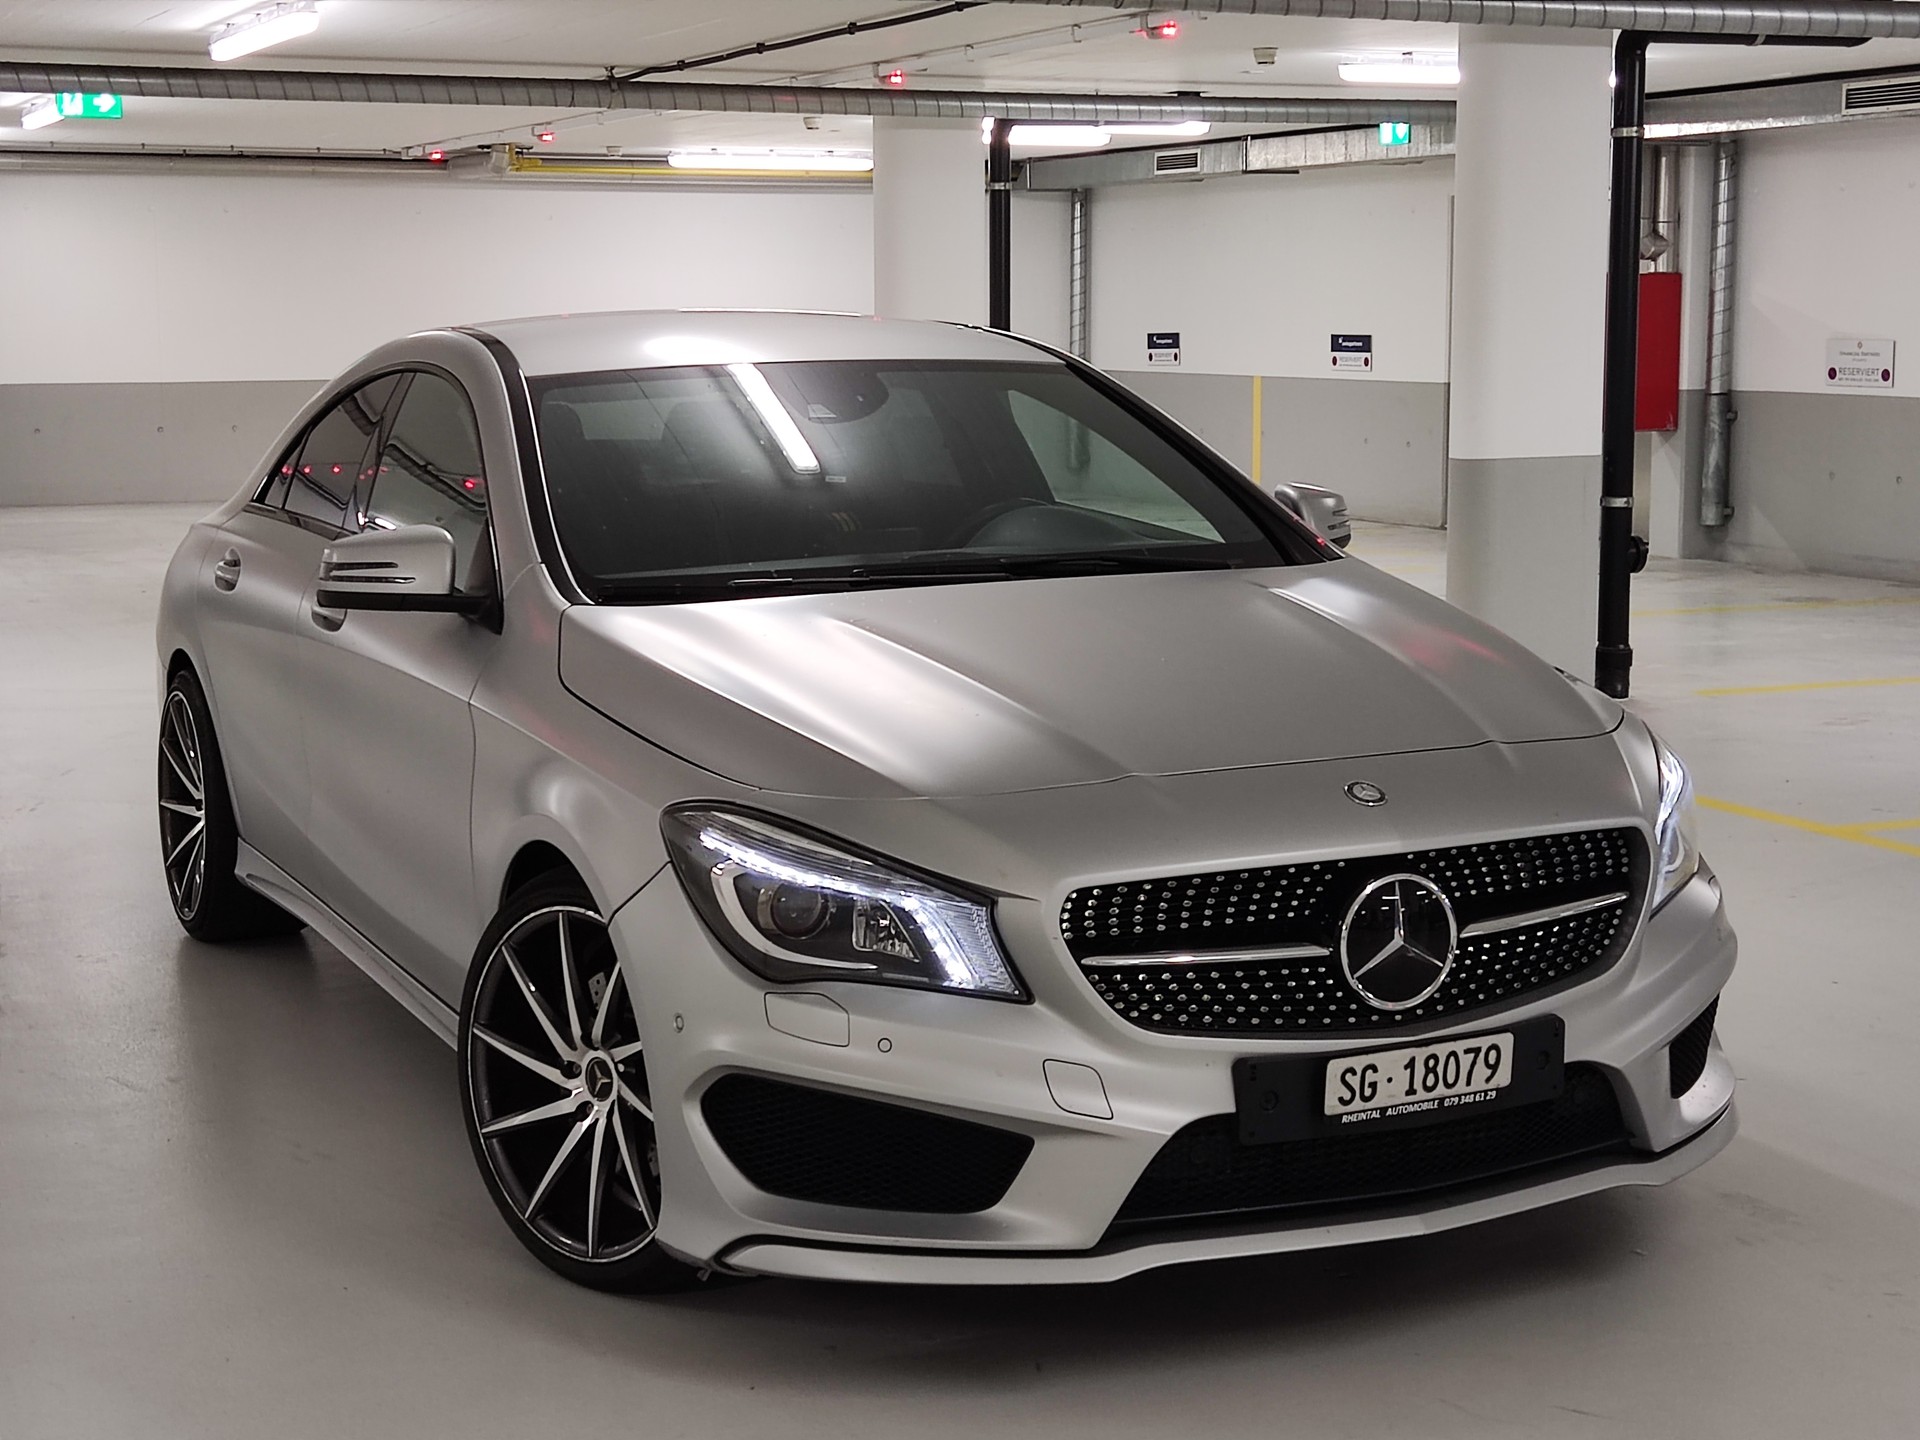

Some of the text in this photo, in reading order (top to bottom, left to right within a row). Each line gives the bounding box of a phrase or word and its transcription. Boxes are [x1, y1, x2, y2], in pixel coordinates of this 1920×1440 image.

[1838, 367, 1880, 376] RESERVIERT
[1341, 1109, 1381, 1124] RHEINTAL
[1385, 1099, 1440, 1117] AUTOMOBILE
[1443, 1096, 1459, 1107] 079
[1475, 1092, 1485, 1102] 61
[1486, 1090, 1497, 1100] 29
